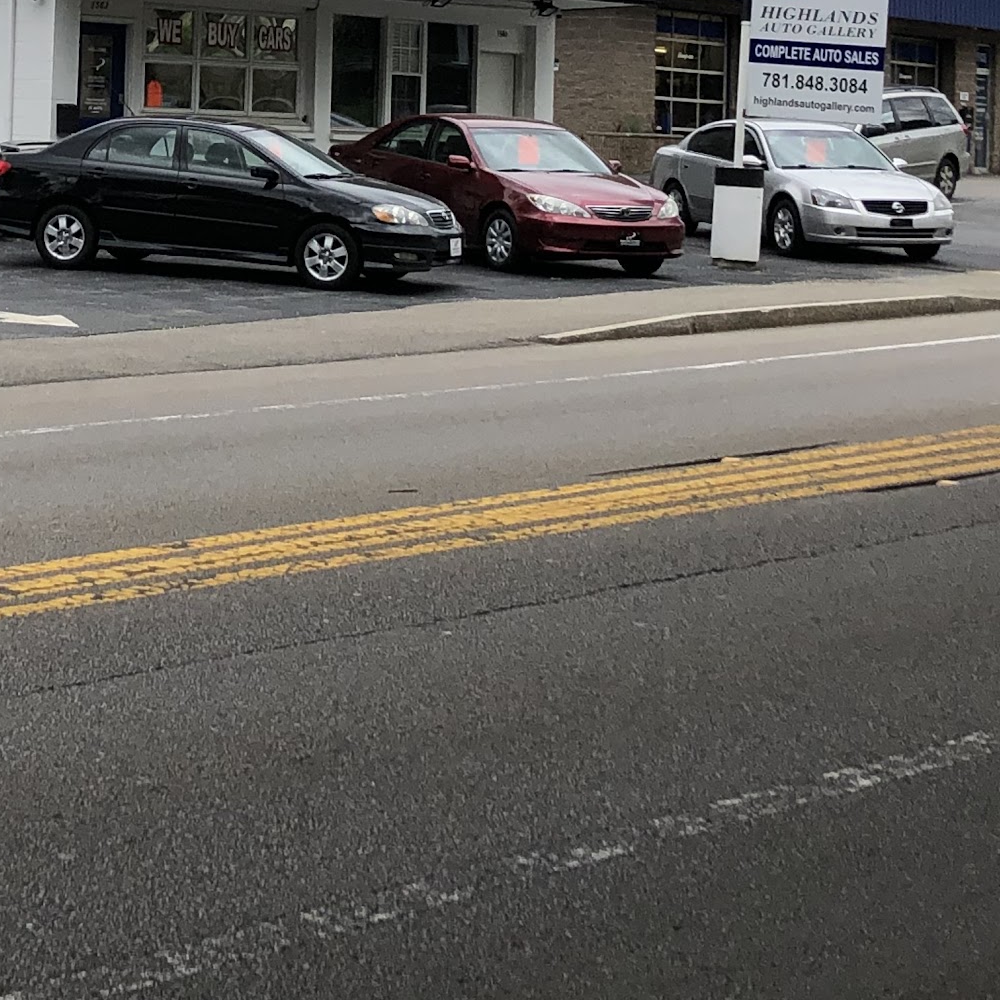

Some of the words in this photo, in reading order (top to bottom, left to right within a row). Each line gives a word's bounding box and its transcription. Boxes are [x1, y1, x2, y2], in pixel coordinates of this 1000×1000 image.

[760, 6, 879, 26] HIGHLANDS
[158, 18, 182, 44] WE
[207, 21, 239, 47] BUY
[258, 25, 292, 50] CARS
[760, 22, 802, 35] AUTO
[806, 24, 877, 39] GALLERY
[754, 44, 811, 61] COMPLETE
[812, 48, 842, 63] AUTO
[844, 50, 879, 65] SALES
[762, 72, 868, 94] 781.848.3084
[753, 96, 875, 114] highlandsautogallery.com
